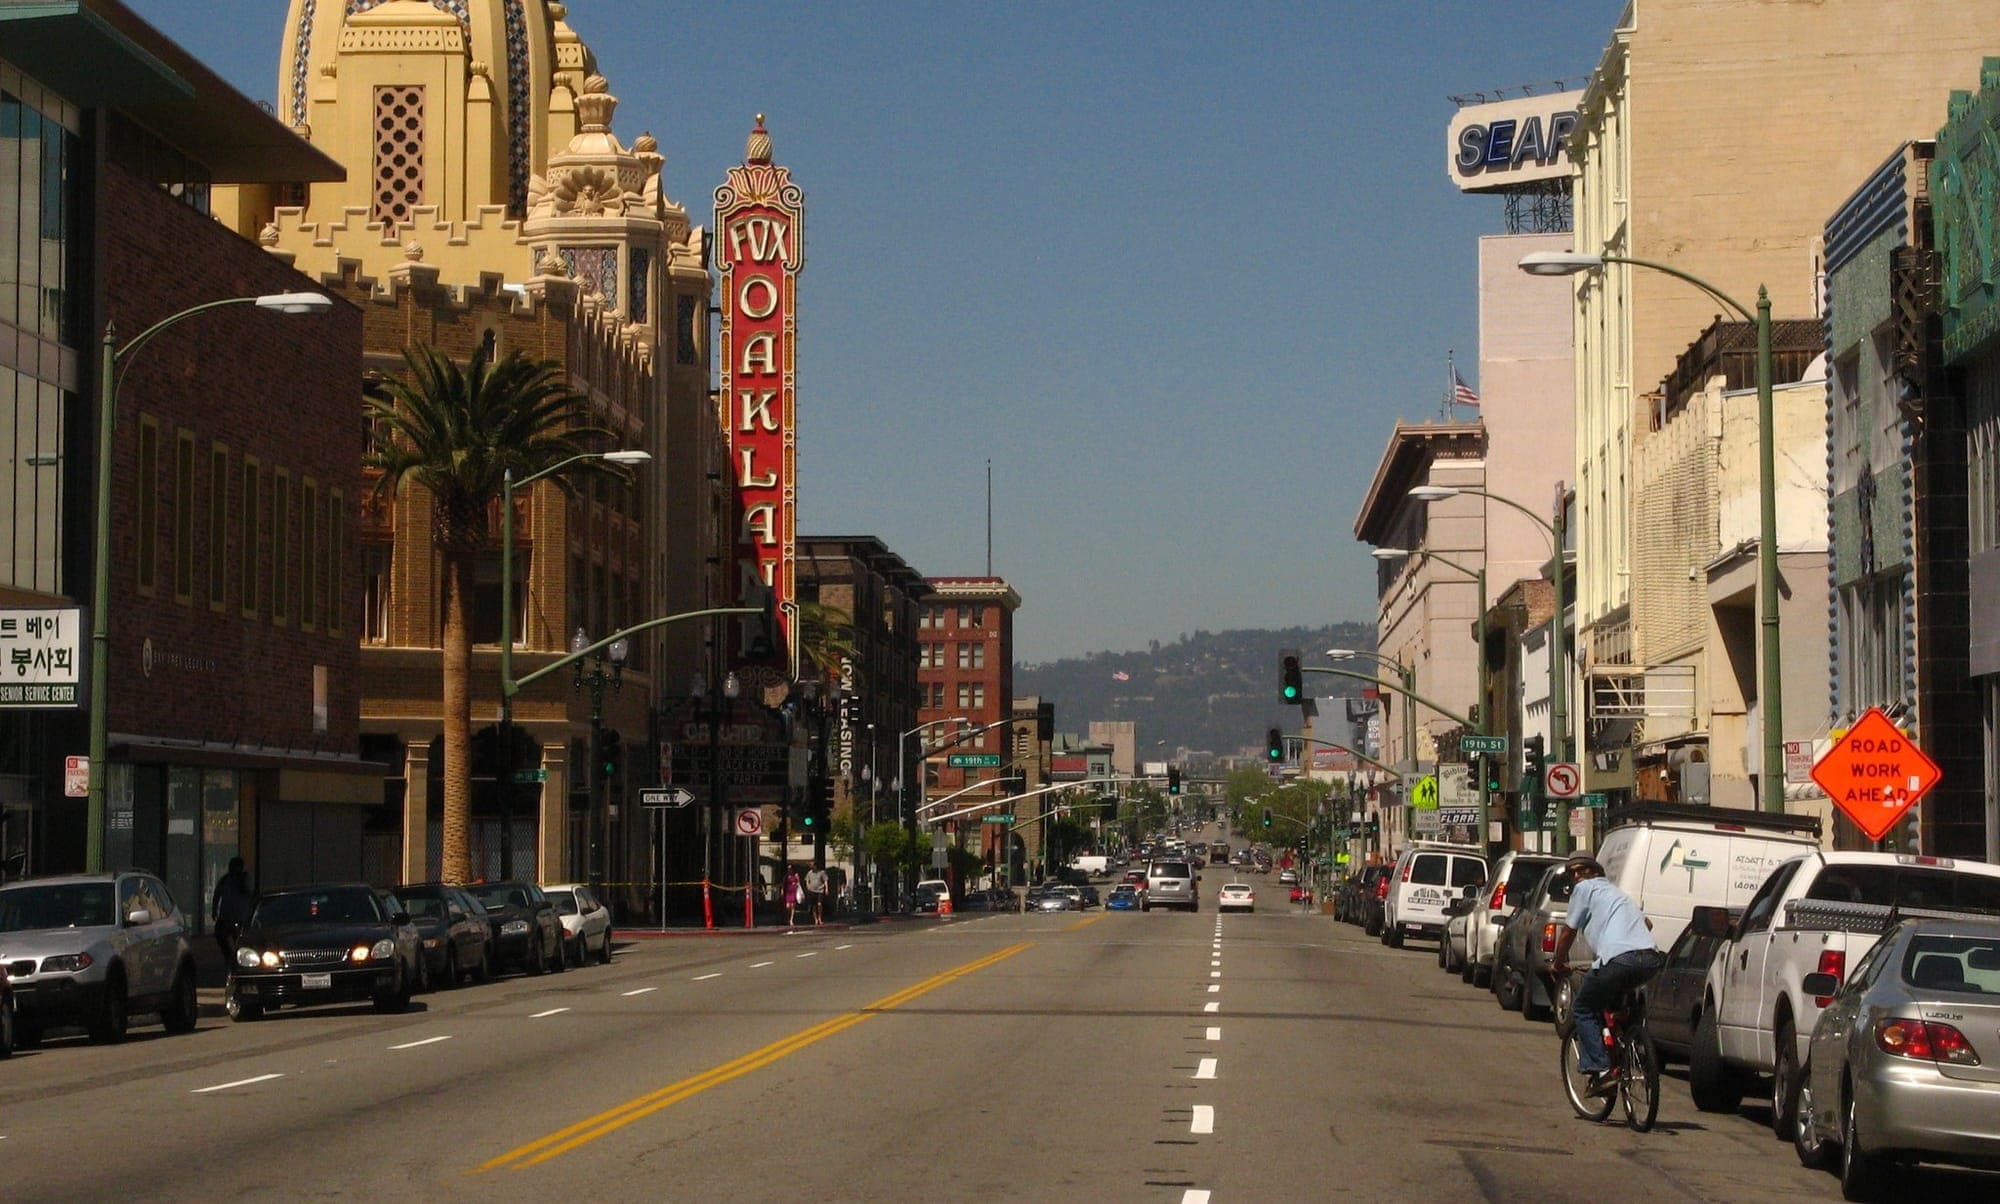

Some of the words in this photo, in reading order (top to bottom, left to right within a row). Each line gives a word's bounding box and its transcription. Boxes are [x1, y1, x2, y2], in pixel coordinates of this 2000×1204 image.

[728, 214, 789, 261] FOX
[26, 616, 60, 639] 베이
[11, 647, 72, 676] 봉사회
[0, 686, 23, 701] SENIOR
[25, 686, 50, 701] SERVICE
[52, 686, 75, 701] CENTER
[840, 698, 852, 776] LEASING
[1465, 740, 1487, 749] 19th
[1490, 740, 1502, 749] St
[1787, 743, 1799, 753] NO
[1851, 739, 1902, 753] ROAD
[965, 757, 982, 765] 19th
[1851, 764, 1901, 777] WORK
[1845, 788, 1909, 802] AHEAD
